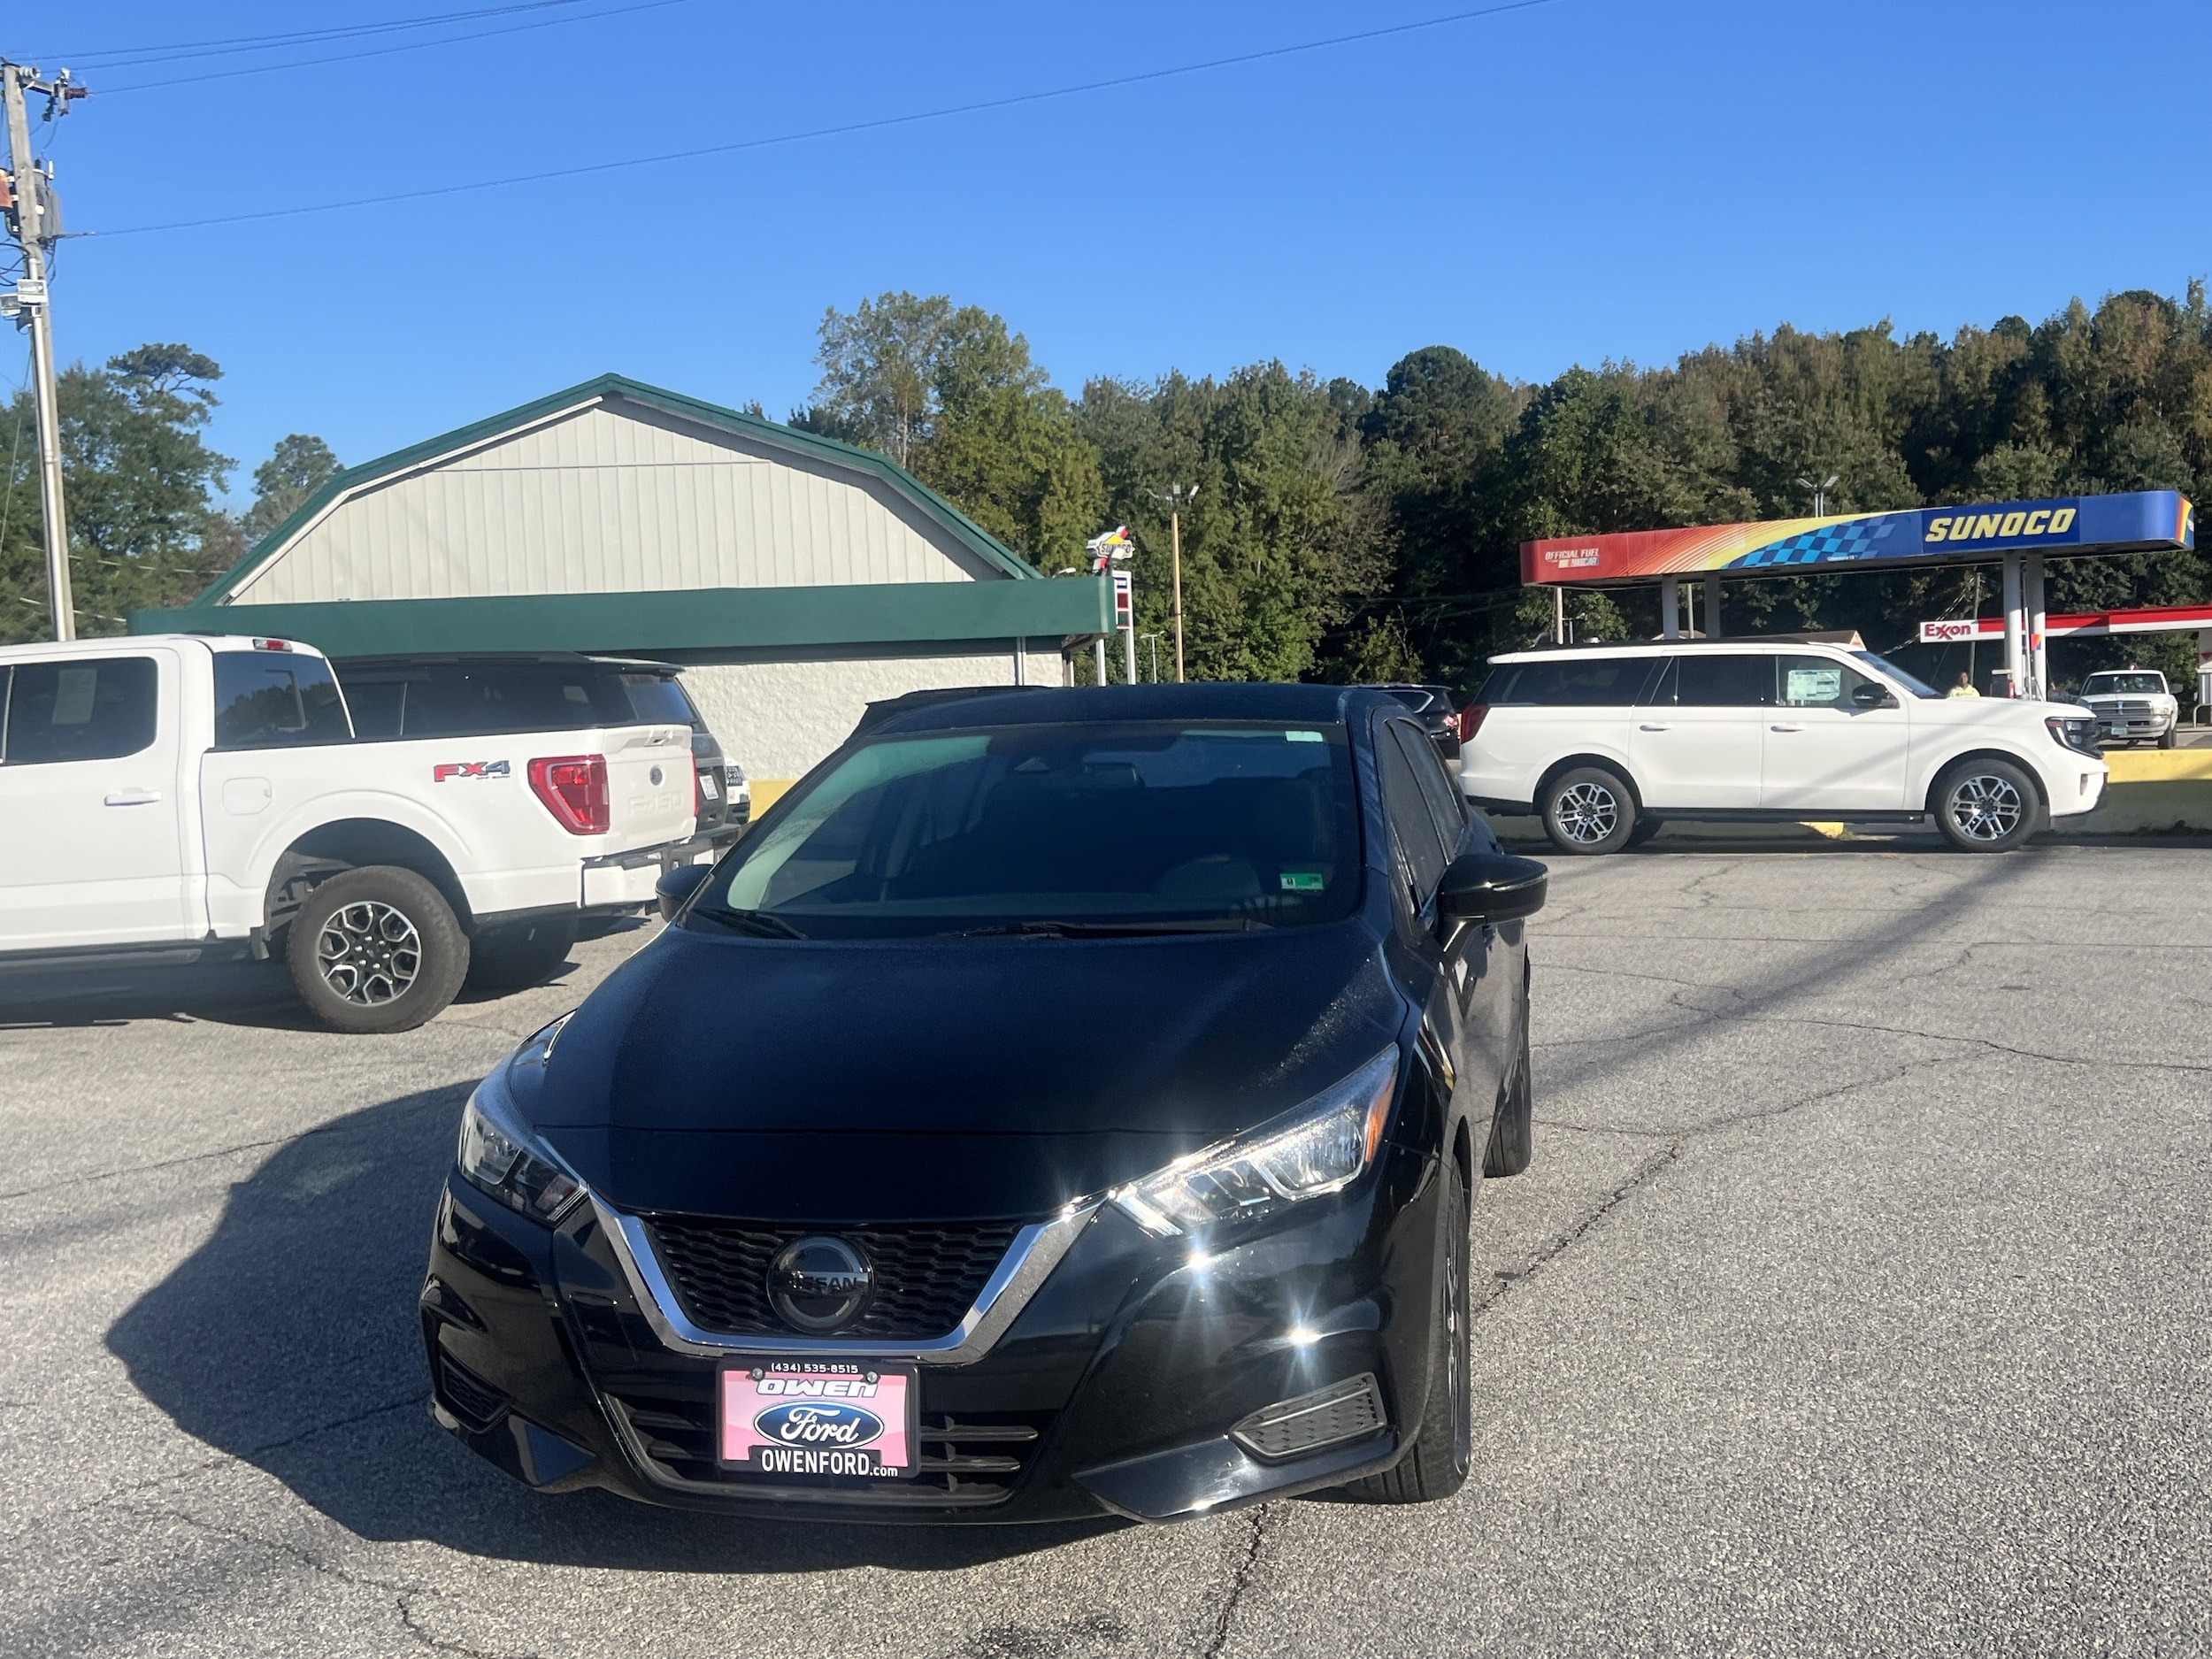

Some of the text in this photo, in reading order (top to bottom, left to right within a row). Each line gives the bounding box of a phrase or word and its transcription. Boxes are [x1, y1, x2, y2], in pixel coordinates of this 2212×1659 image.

[1924, 508, 2077, 542] SUNOCO
[1545, 548, 1600, 560] OFFICIAL FUEL
[1924, 624, 1971, 640] Exxon
[434, 760, 511, 782] FX4
[771, 1363, 858, 1374] (434) 535-8515
[780, 1407, 863, 1442] Ford
[761, 1448, 899, 1477] OWENFORD.com
